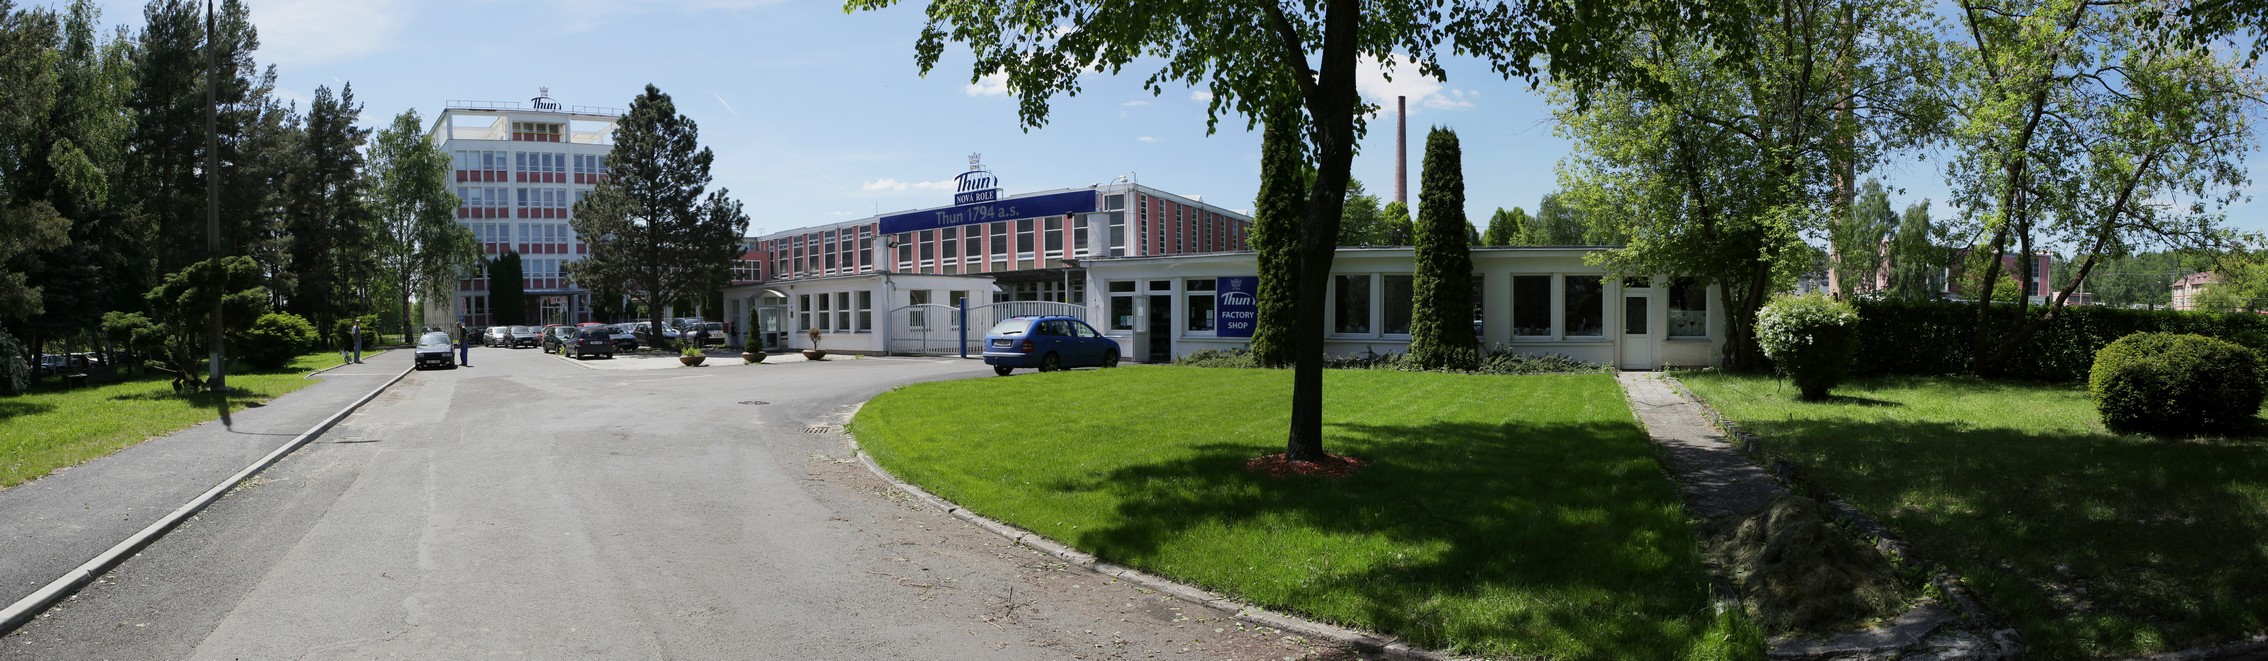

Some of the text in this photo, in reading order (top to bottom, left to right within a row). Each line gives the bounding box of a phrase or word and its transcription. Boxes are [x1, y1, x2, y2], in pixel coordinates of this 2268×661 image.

[531, 97, 562, 110] Thun
[954, 171, 998, 192] Thun
[956, 191, 994, 204] NOVÁ ROLE
[936, 205, 1019, 225] Thun 1794 a.s.
[1221, 291, 1256, 306] Thun
[1222, 311, 1254, 319] FACTORY
